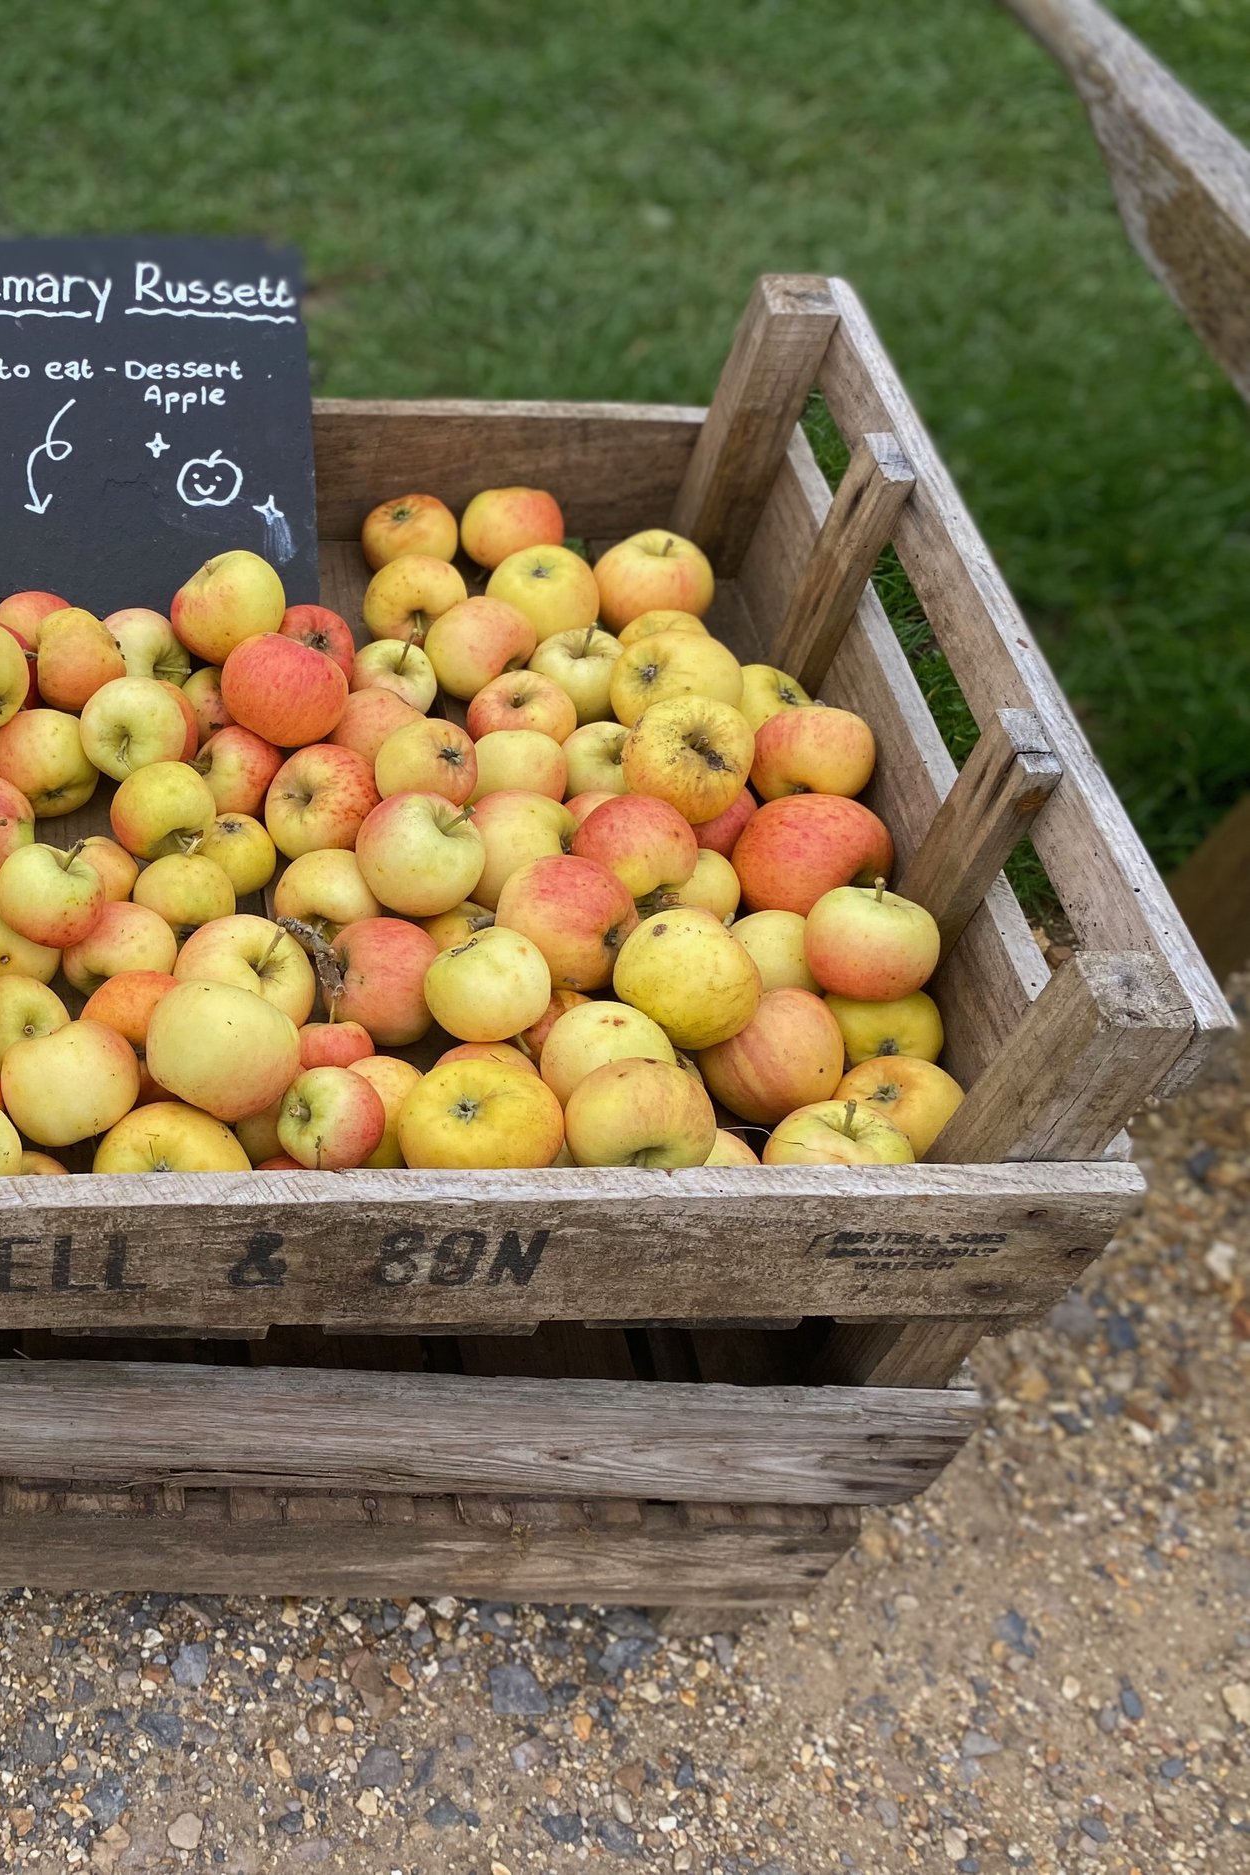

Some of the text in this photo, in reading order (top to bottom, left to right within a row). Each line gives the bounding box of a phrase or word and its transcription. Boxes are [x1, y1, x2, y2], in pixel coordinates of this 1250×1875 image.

[135, 262, 296, 308] Russett
[44, 358, 94, 381] eat
[124, 360, 243, 380] Dessert
[144, 385, 226, 414] Apple
[227, 1231, 287, 1288] &
